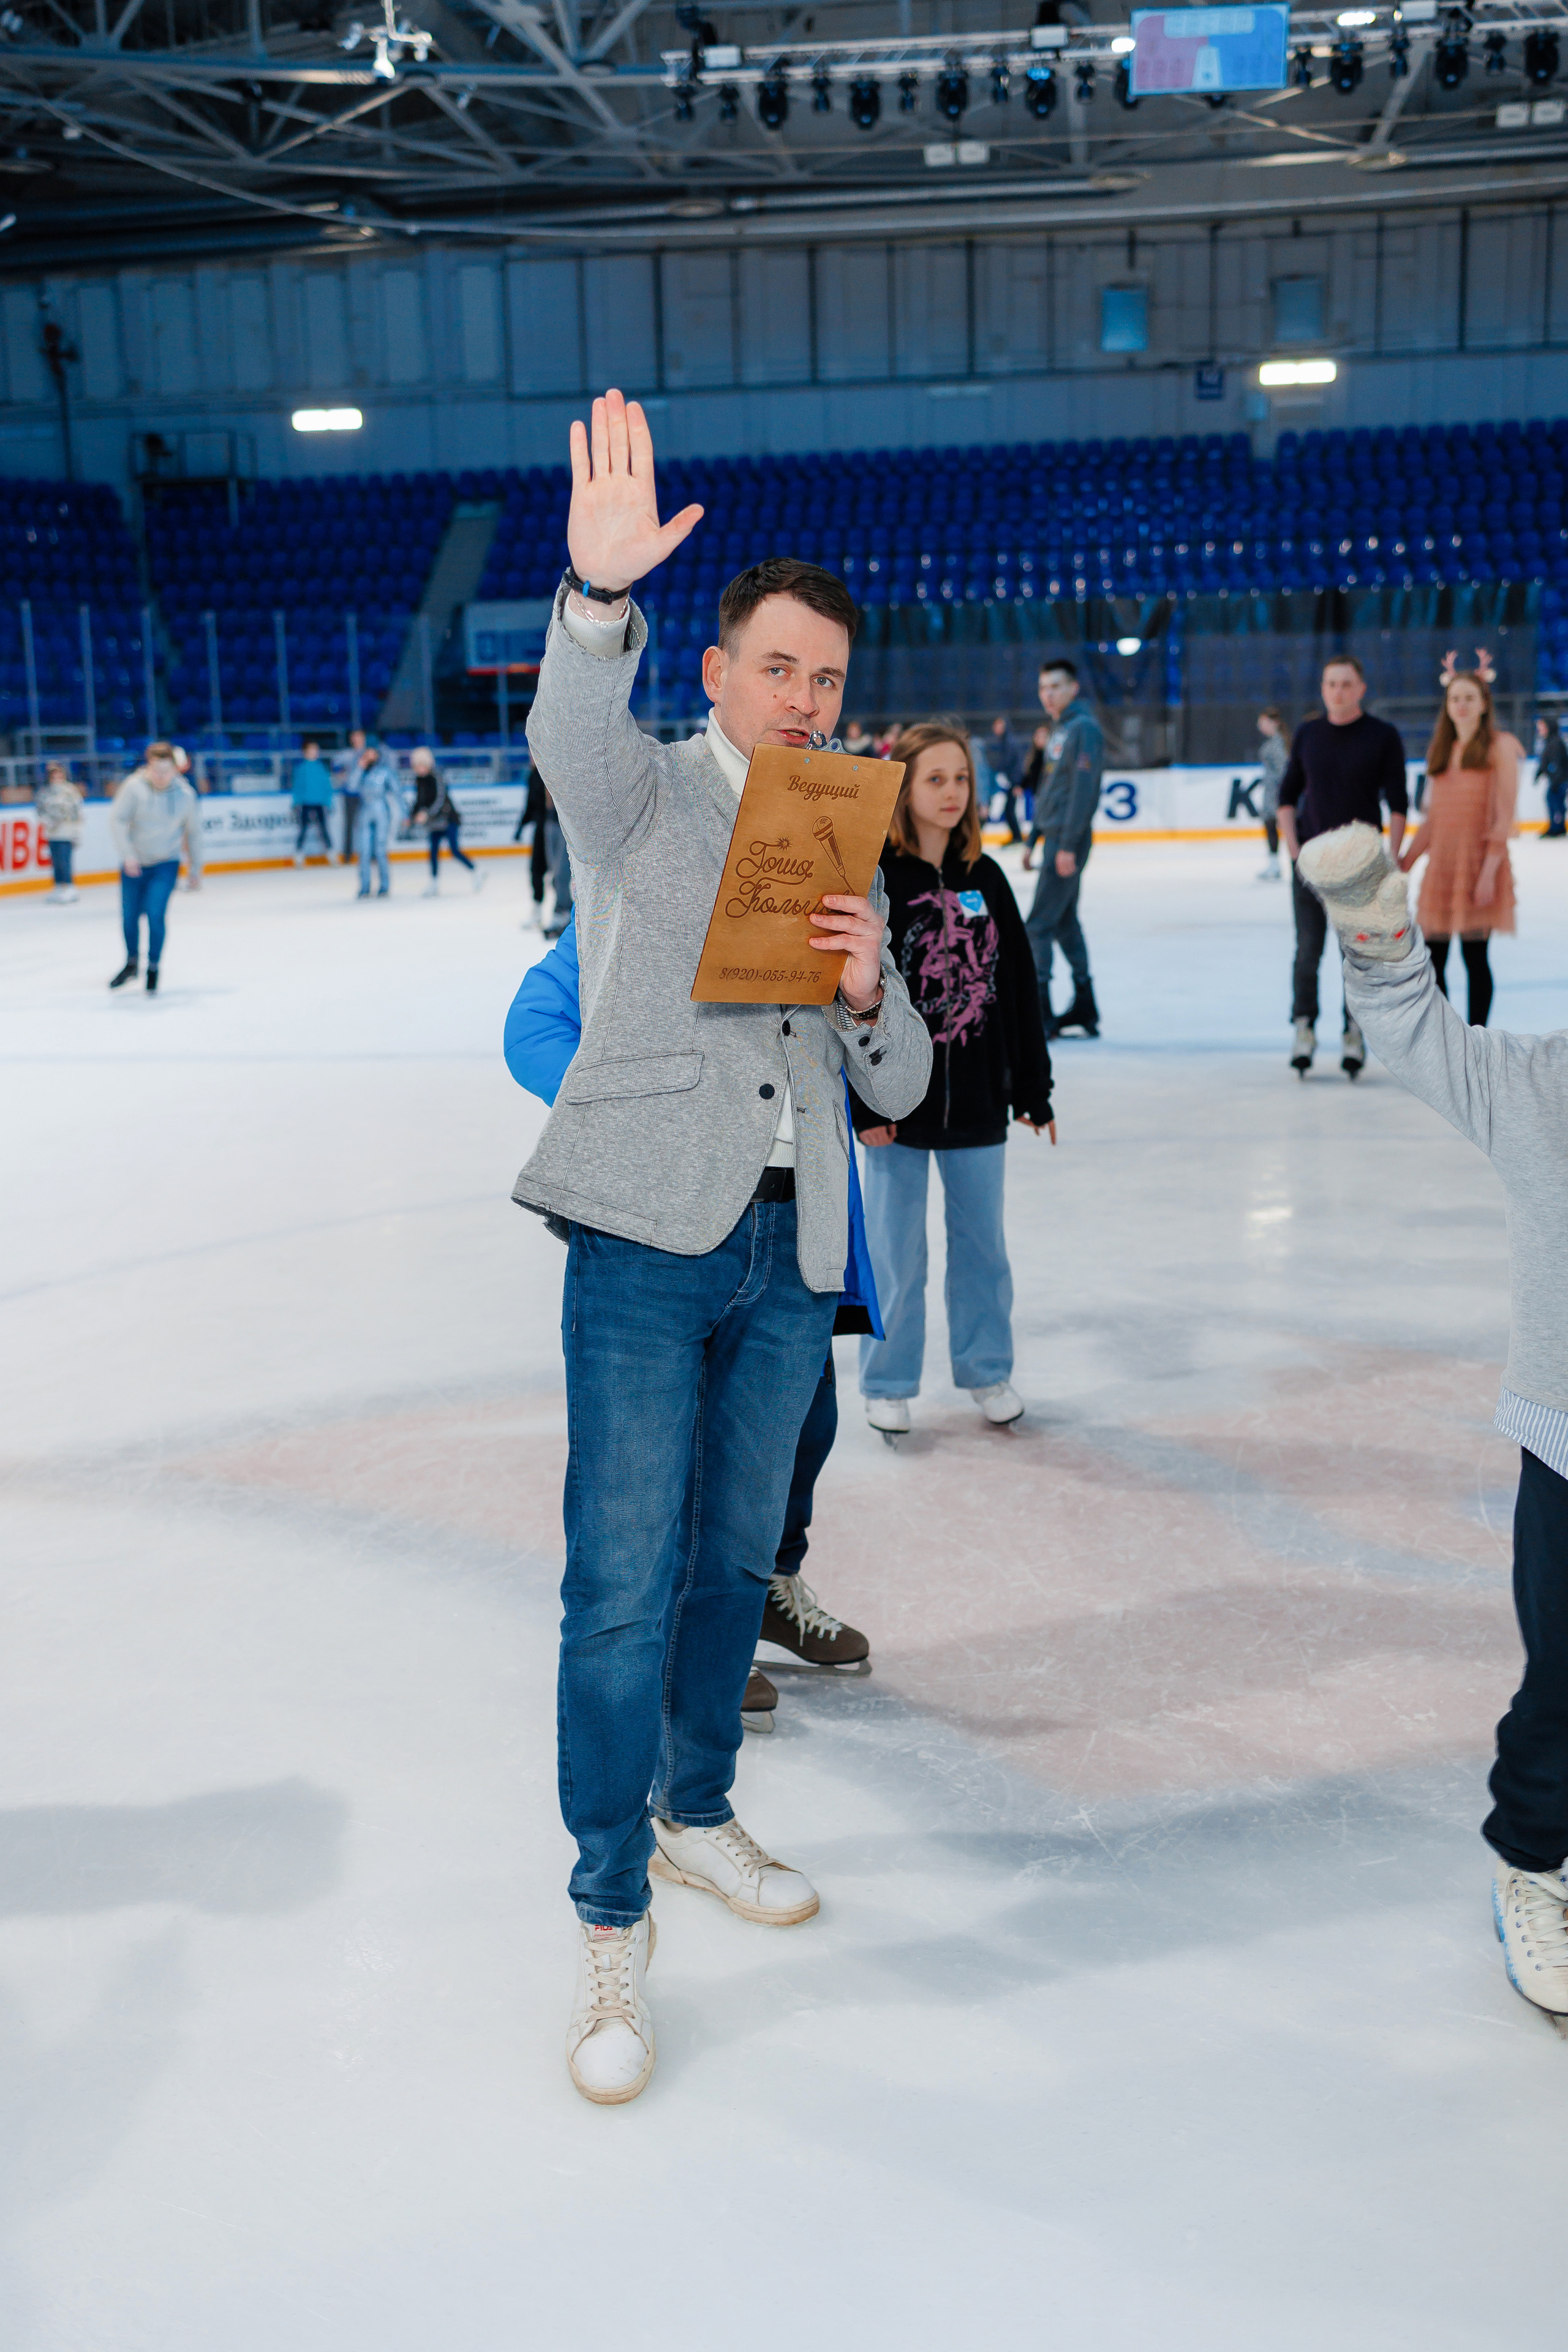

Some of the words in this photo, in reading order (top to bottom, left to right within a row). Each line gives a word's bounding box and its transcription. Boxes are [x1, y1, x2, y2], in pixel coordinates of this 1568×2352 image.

[787, 775, 861, 801] Ведущий
[736, 840, 815, 879] Гоша
[718, 967, 822, 984] 8(920)-055-94-76
